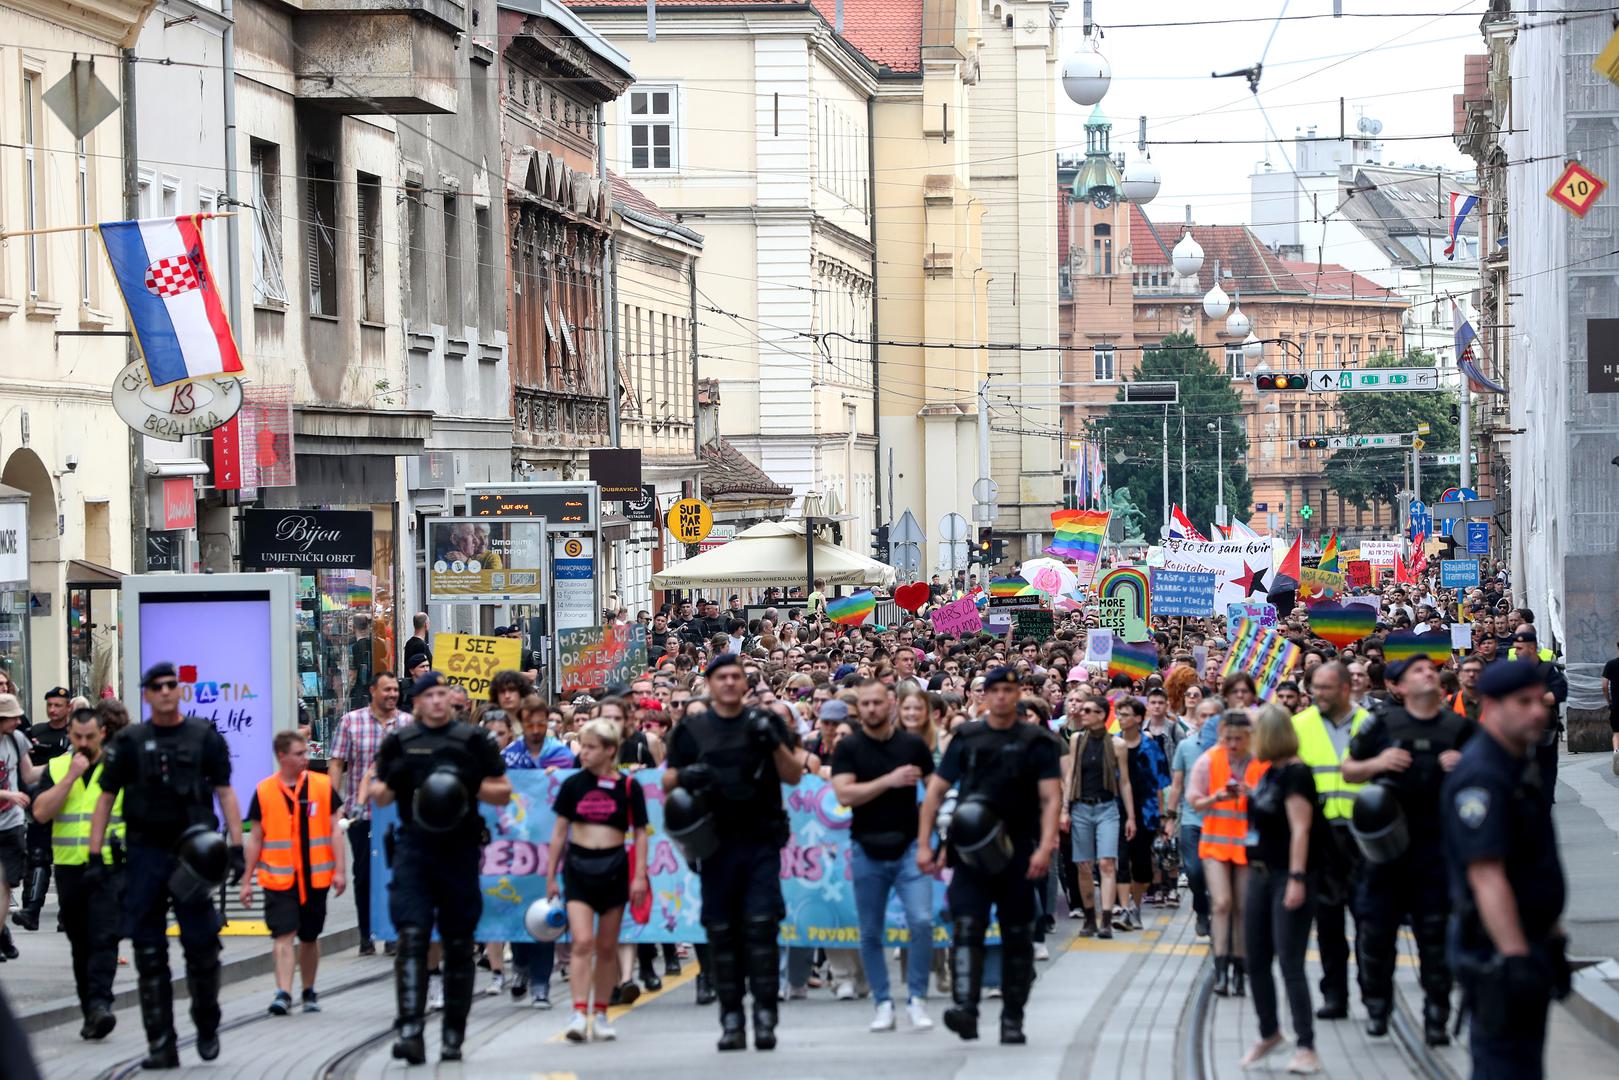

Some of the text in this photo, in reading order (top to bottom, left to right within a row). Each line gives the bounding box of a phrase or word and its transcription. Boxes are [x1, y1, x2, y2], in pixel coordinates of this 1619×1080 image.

[1567, 181, 1588, 197] 10
[680, 504, 701, 515] SUB
[680, 515, 701, 527] MAR
[275, 515, 342, 552] Bijou
[1197, 542, 1215, 553] što
[1218, 543, 1242, 554] sam
[1246, 541, 1271, 554] kvir
[261, 552, 356, 563] UMJETNIČKI OBRT
[1188, 575, 1196, 583] JE
[1100, 599, 1125, 607] MORE
[1100, 609, 1125, 617] LOVE
[1100, 618, 1125, 627] LESS
[615, 626, 645, 643] NIJE
[454, 637, 496, 654] I SEE
[448, 653, 500, 675] GAY
[564, 663, 648, 687] VRIJEDNOST
[448, 675, 490, 694] PEOP
[228, 708, 253, 732] life
